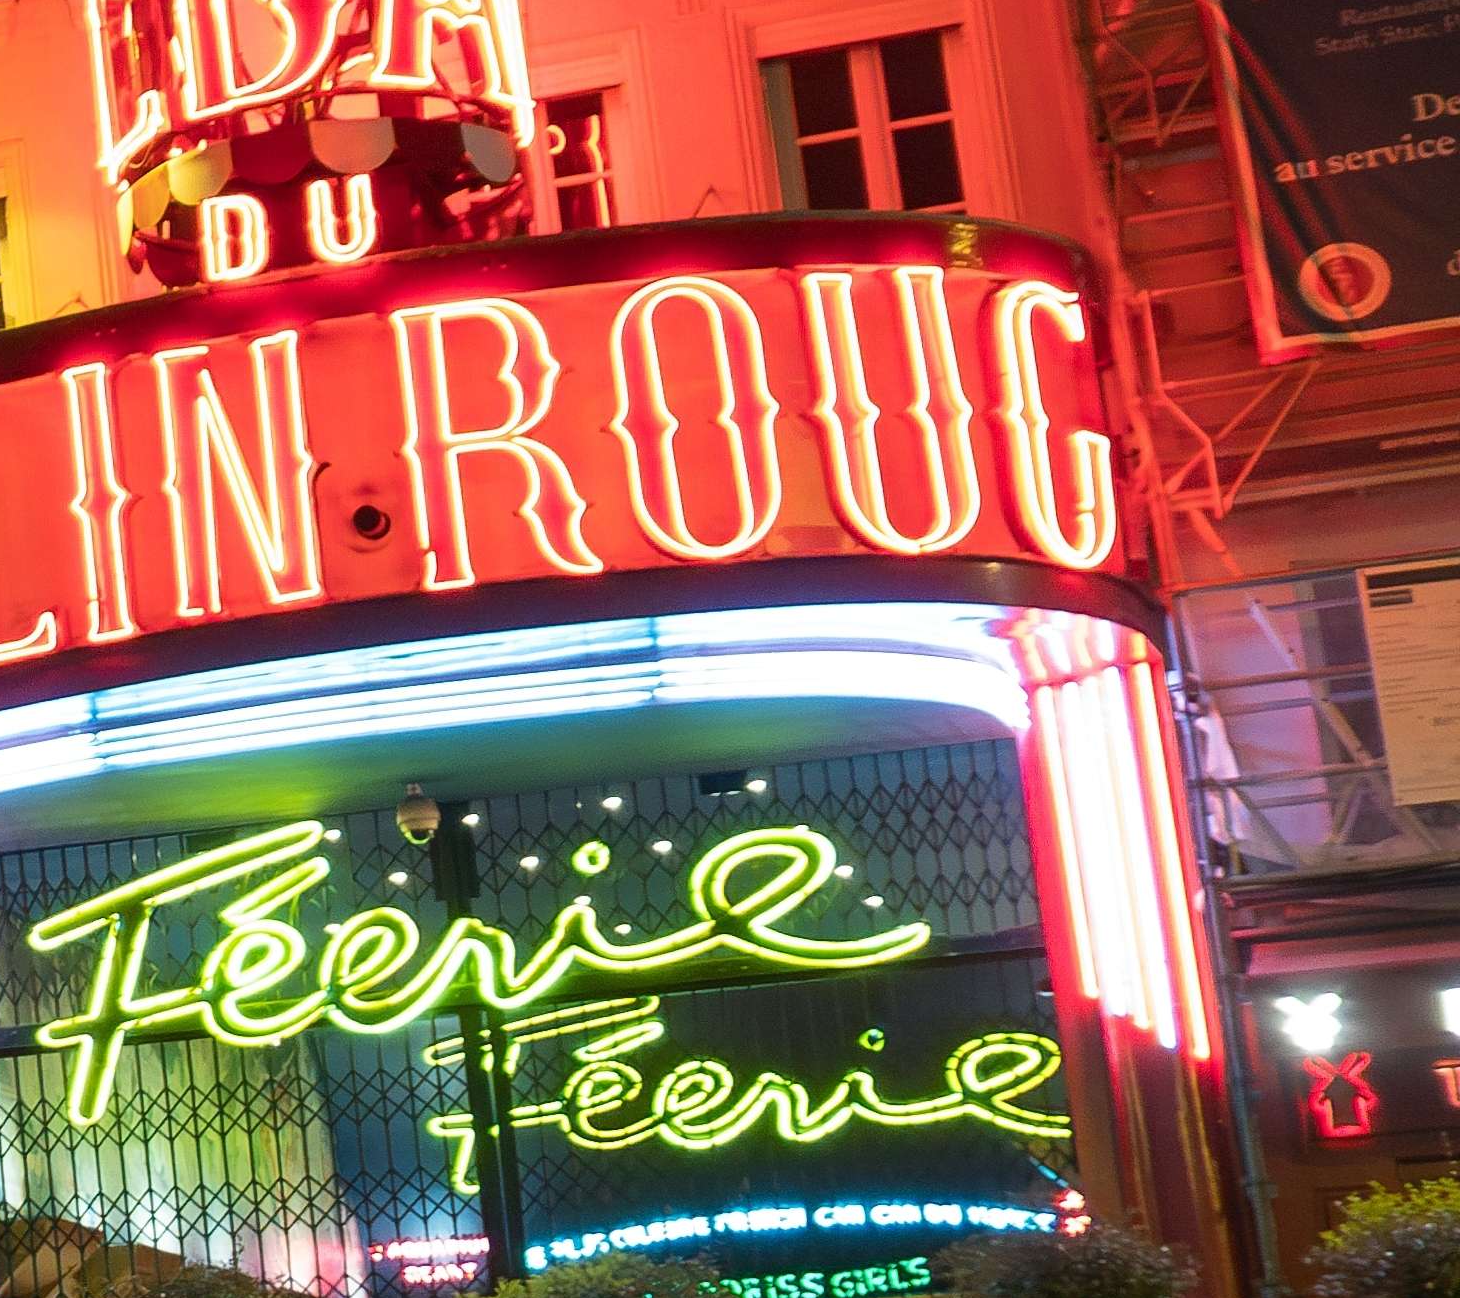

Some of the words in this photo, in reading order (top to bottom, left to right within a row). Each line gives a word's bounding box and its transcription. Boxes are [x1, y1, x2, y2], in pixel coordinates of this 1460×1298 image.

[1325, 133, 1457, 175] service
[201, 172, 377, 282] DU
[391, 263, 1118, 591] ROUG
